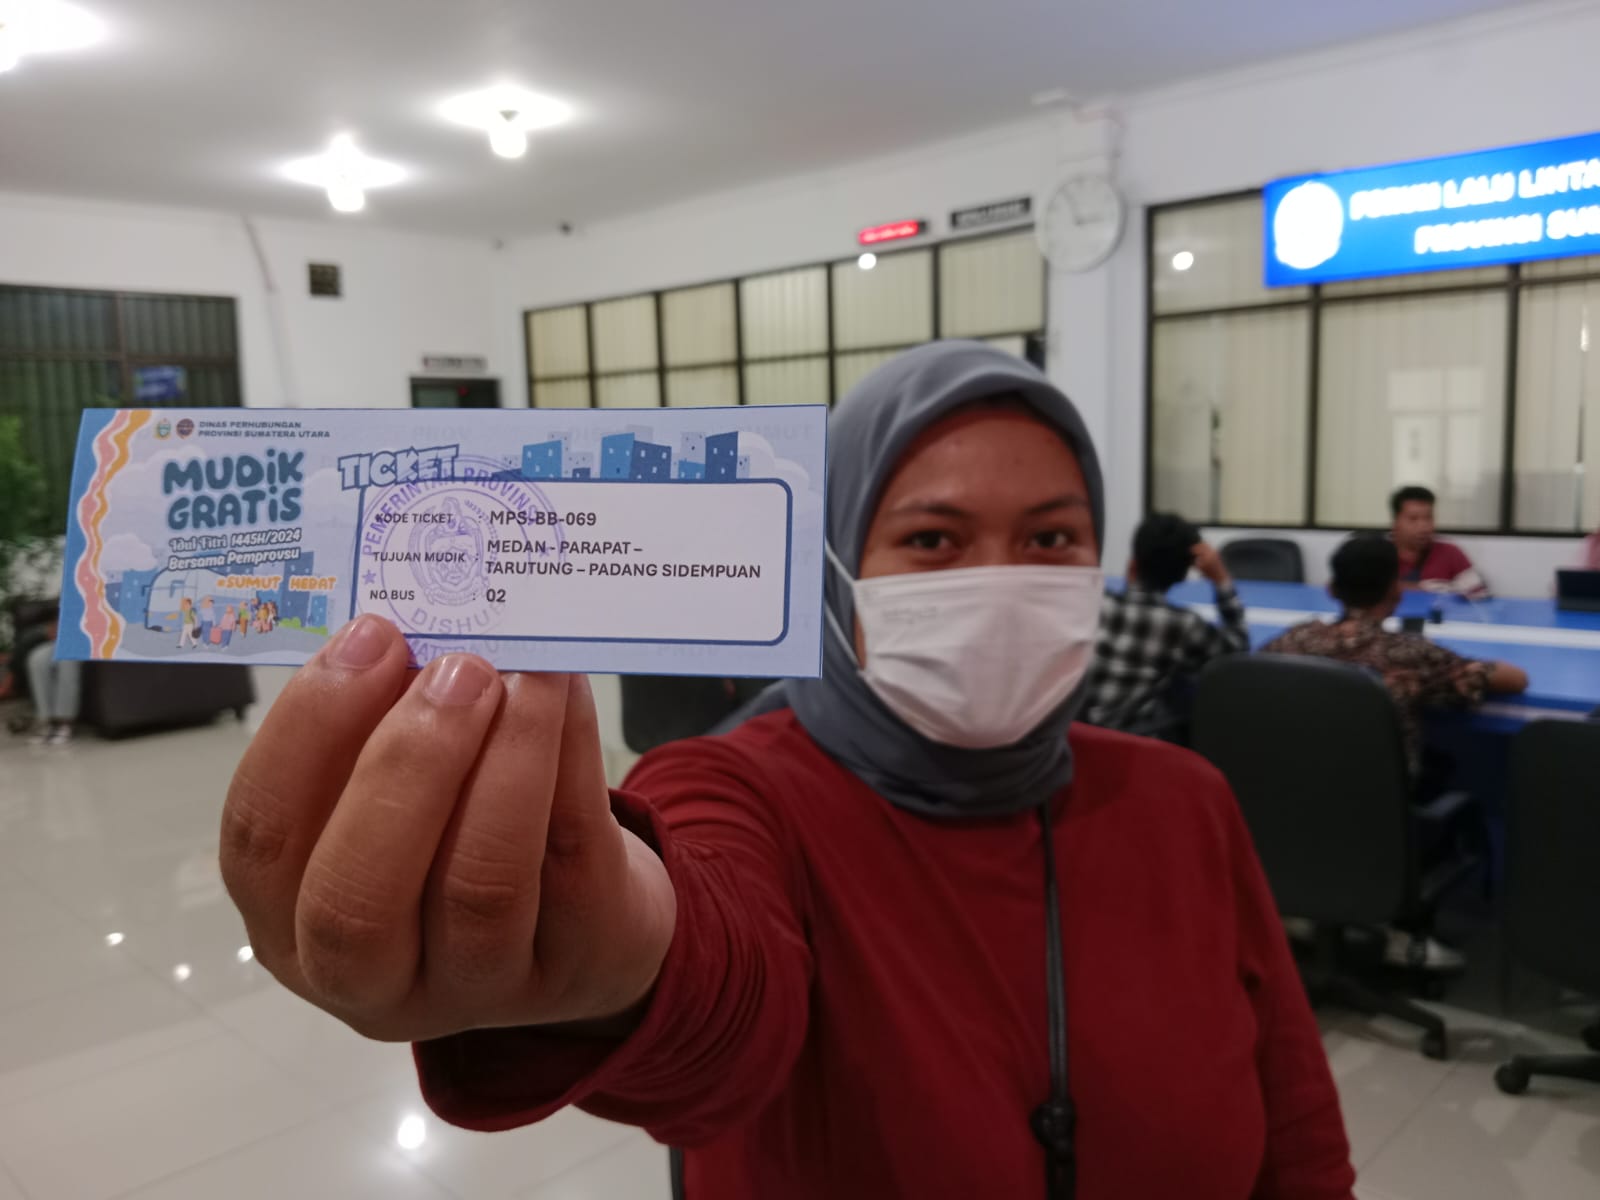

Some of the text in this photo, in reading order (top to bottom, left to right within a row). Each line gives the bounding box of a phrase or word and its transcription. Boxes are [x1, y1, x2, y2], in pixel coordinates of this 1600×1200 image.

[199, 421, 302, 429] DINAS PERHUBUNGAN
[198, 430, 331, 438] PROVINSI SUMATERA UTARA
[338, 443, 460, 491] TICKET
[375, 513, 409, 524] KODE
[412, 513, 453, 524] TICKET
[489, 511, 597, 527] MPS-BB-069
[168, 528, 302, 553] Idul Fitri 1445H/2024
[487, 540, 547, 554] MEDAN
[560, 541, 632, 554] PARAPAT
[168, 546, 300, 571] Bersama Pemprovsu
[373, 551, 421, 562] TUJUAN
[424, 551, 466, 562] MUDIK
[485, 561, 573, 575] TARUTUNG
[589, 563, 658, 577] PADANG
[662, 564, 761, 578] SIDEMPUAN
[288, 576, 338, 592] HEBAT
[370, 590, 388, 600] NO
[390, 590, 415, 600] BUS
[486, 589, 507, 603] 02
